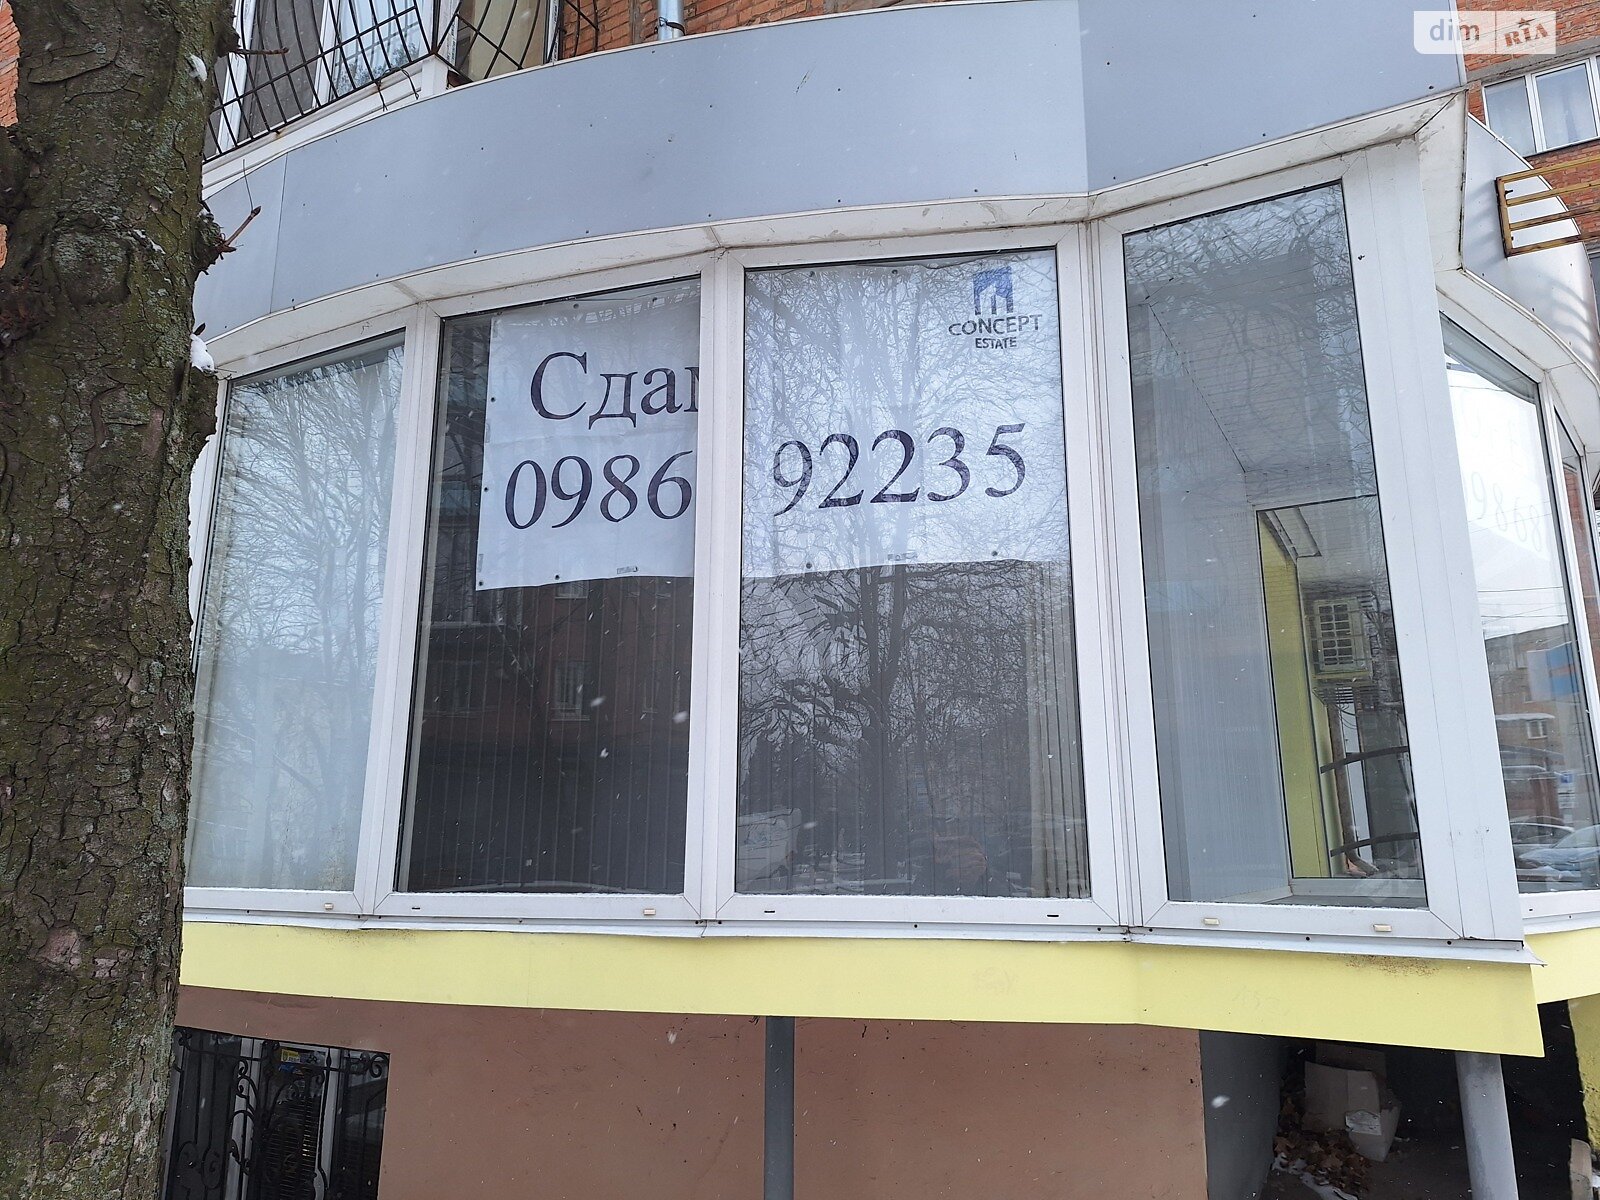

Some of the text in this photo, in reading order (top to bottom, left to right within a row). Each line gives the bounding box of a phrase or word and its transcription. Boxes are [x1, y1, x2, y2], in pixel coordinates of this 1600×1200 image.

[948, 314, 1043, 336] CONCEPT
[975, 337, 1017, 350] ESTATE
[505, 423, 1026, 530] 0986 92235
